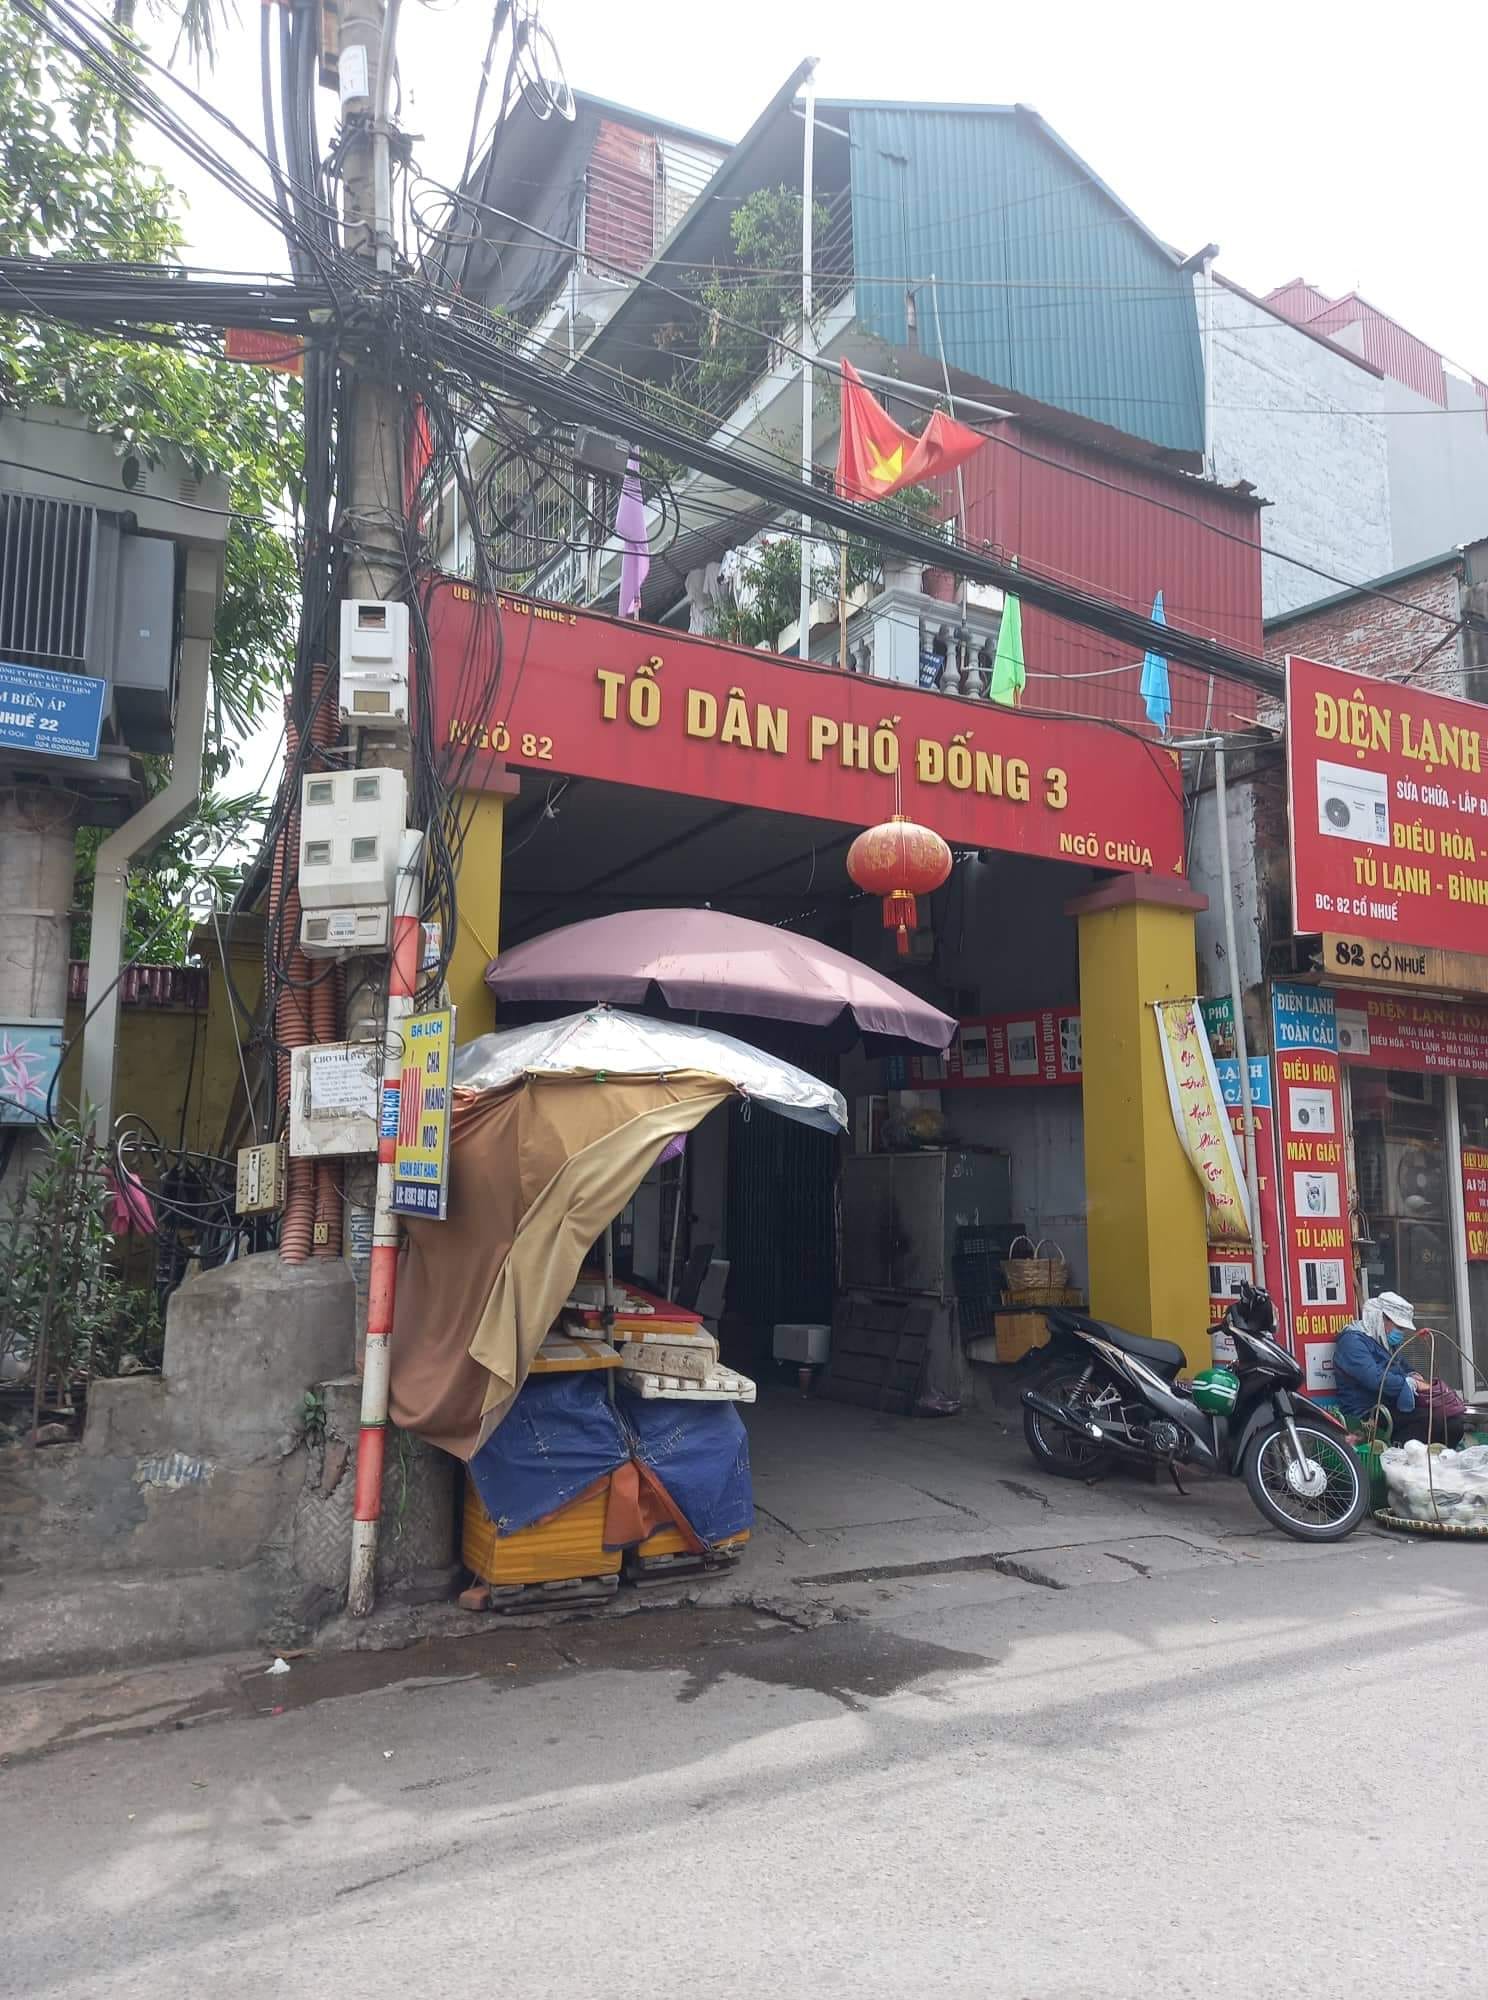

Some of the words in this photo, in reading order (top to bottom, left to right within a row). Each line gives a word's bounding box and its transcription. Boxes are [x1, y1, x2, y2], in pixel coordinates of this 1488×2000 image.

[568, 614, 577, 626] 2
[11, 691, 45, 709] BIẾN
[47, 697, 67, 711] ÁP
[39, 718, 59, 732] 22
[597, 656, 664, 728] TỔ
[687, 687, 788, 753] DÂN
[809, 714, 902, 774] PHỐ
[916, 731, 1030, 802] ĐỐNG
[1046, 767, 1068, 809] 3
[1315, 688, 1392, 759] ĐIỆN
[1400, 713, 1481, 773] LẠNH
[521, 733, 553, 760] 82
[1396, 774, 1419, 802] SỬA
[1421, 784, 1449, 808] CHỮA
[1459, 789, 1477, 814] LẮP
[1059, 832, 1099, 857] NGÕ
[1104, 840, 1153, 867] CHÙA
[1394, 817, 1435, 854] ĐIỀU
[1440, 828, 1476, 862] HÒA
[1353, 847, 1377, 886] TỦ
[1382, 862, 1431, 896] LẠNH
[1315, 894, 1334, 911] ĐC:
[1337, 897, 1350, 913] 82
[1353, 895, 1367, 916] CỔ
[1370, 900, 1398, 921] NHUẾ
[1335, 941, 1365, 967] 82
[1371, 947, 1392, 969] CỔ
[1395, 954, 1425, 975] NHUẾ
[1277, 989, 1303, 1016] ĐIỆN
[1306, 996, 1335, 1018] LẠNH
[1280, 1019, 1310, 1042] TOÀN
[1313, 1021, 1334, 1044] CẦU
[1217, 1063, 1263, 1084] LẠH
[1283, 1056, 1309, 1081] ĐIỀU
[1313, 1061, 1336, 1083] HÒA
[1287, 1138, 1315, 1161] MÁY
[1316, 1140, 1341, 1166] GIẶT
[1296, 1220, 1310, 1248] TỦ
[1314, 1228, 1345, 1251] LẠNH
[1296, 1308, 1309, 1335] ĐỒ
[1312, 1314, 1328, 1335] GIA
